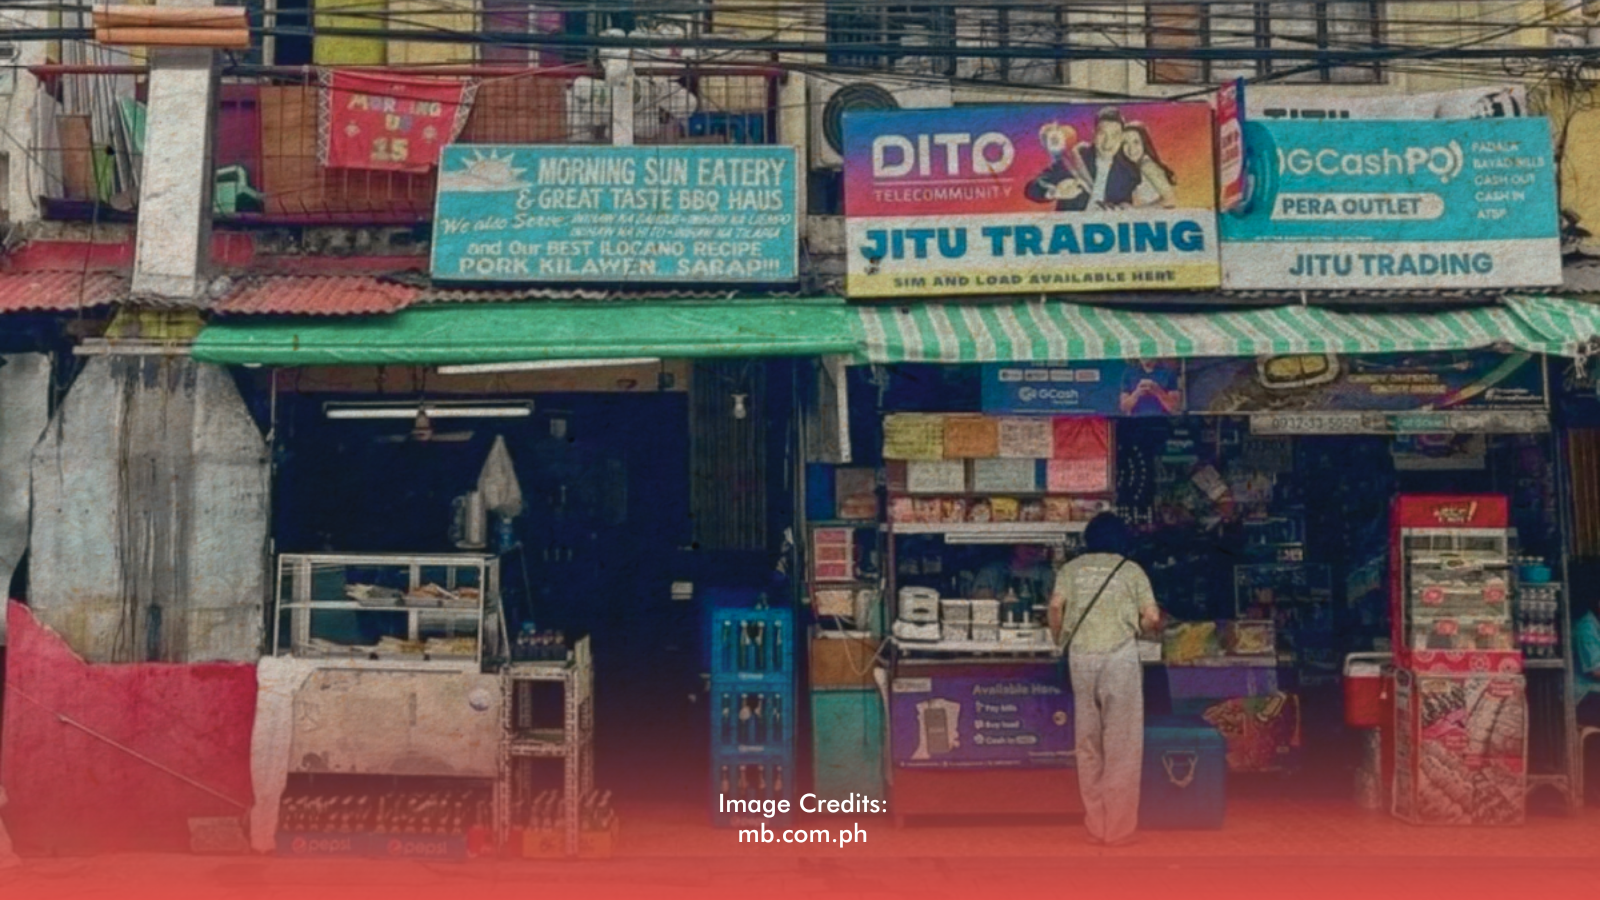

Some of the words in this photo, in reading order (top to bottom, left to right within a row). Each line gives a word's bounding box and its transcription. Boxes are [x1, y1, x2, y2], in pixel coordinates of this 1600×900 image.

[371, 138, 409, 161] 15
[873, 132, 1015, 177] DITO
[538, 157, 635, 185] MORNING
[644, 157, 688, 186] SUN
[697, 157, 786, 186] EATERY
[1474, 174, 1508, 186] CASH
[1511, 173, 1536, 185] OUT
[516, 188, 534, 210] &
[539, 188, 603, 209] GREAT
[610, 188, 673, 209] TASTE
[679, 189, 720, 212] BBQ
[728, 190, 783, 211] HAUS
[874, 186, 1013, 203] TELECOMMUNITY
[1475, 191, 1509, 202] CASH
[1282, 199, 1337, 215] PERA
[1342, 198, 1421, 214] OUTLET
[441, 218, 470, 234] We
[474, 216, 508, 231] also
[468, 240, 501, 255] and
[508, 241, 541, 255] Our
[547, 241, 594, 255] BEST
[600, 241, 685, 256] ILOCANO
[693, 241, 762, 256] RECIPE
[860, 226, 967, 260] JITU
[982, 220, 1205, 257] TRADING
[459, 257, 529, 274] PORK
[677, 258, 780, 276] SARAP!!!
[1289, 254, 1352, 276] JITU
[1358, 253, 1493, 276] TRADING
[894, 277, 925, 288] SIM
[933, 276, 969, 287] AND
[976, 275, 1023, 286] LOAD
[1029, 272, 1125, 284] AVAILABLE
[1132, 270, 1176, 282] HERE
[1038, 388, 1079, 399] GCash
[973, 683, 1029, 695] Available
[308, 837, 351, 853] pepsi
[403, 839, 447, 854] pepsi
